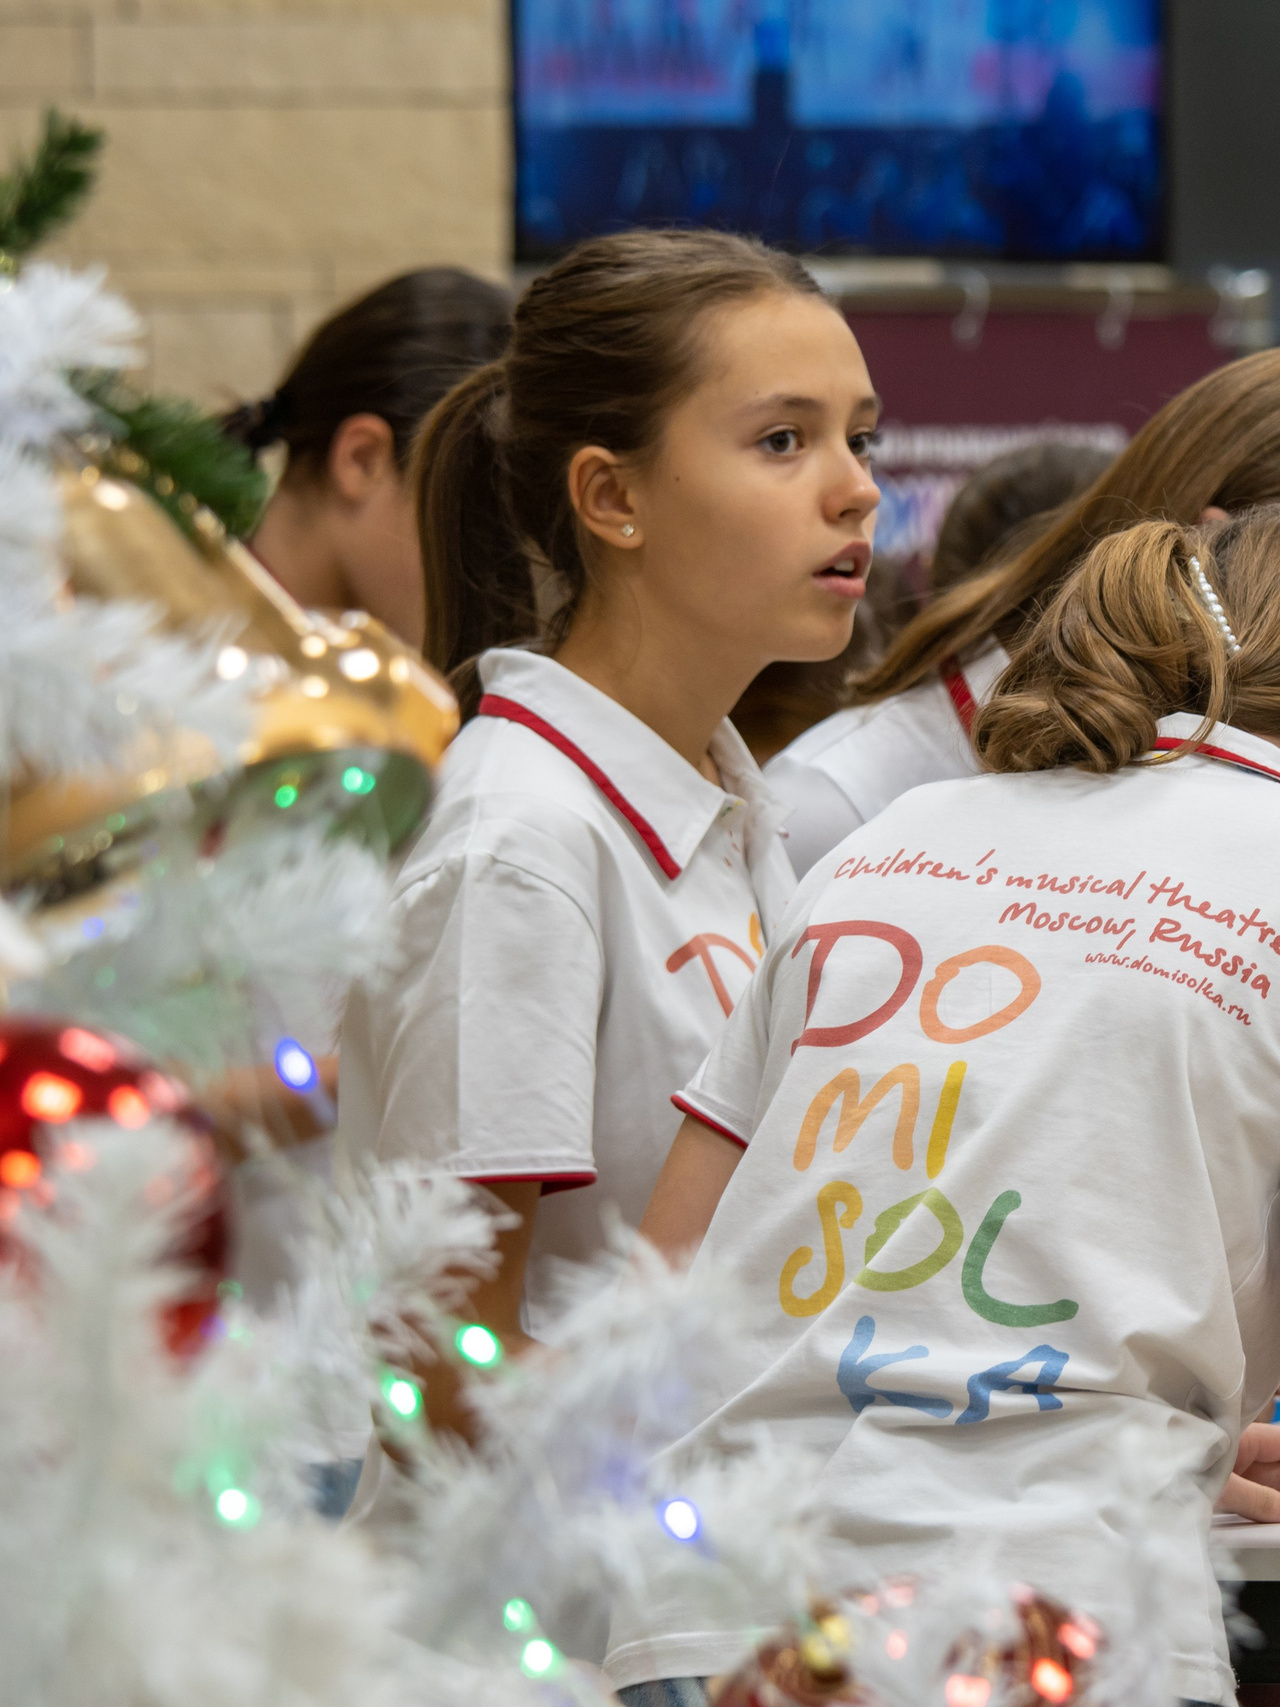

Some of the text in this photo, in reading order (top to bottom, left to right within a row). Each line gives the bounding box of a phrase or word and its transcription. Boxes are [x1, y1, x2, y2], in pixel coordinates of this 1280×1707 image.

[1005, 870, 1147, 900] musical
[790, 919, 1042, 1057] DO
[999, 902, 1271, 999] Moscow, Russia
[1085, 952, 1252, 1026] www.domisolka.ru
[793, 1060, 968, 1180] MI
[779, 1180, 1080, 1329] SOL
[836, 1315, 1070, 1426] KA
